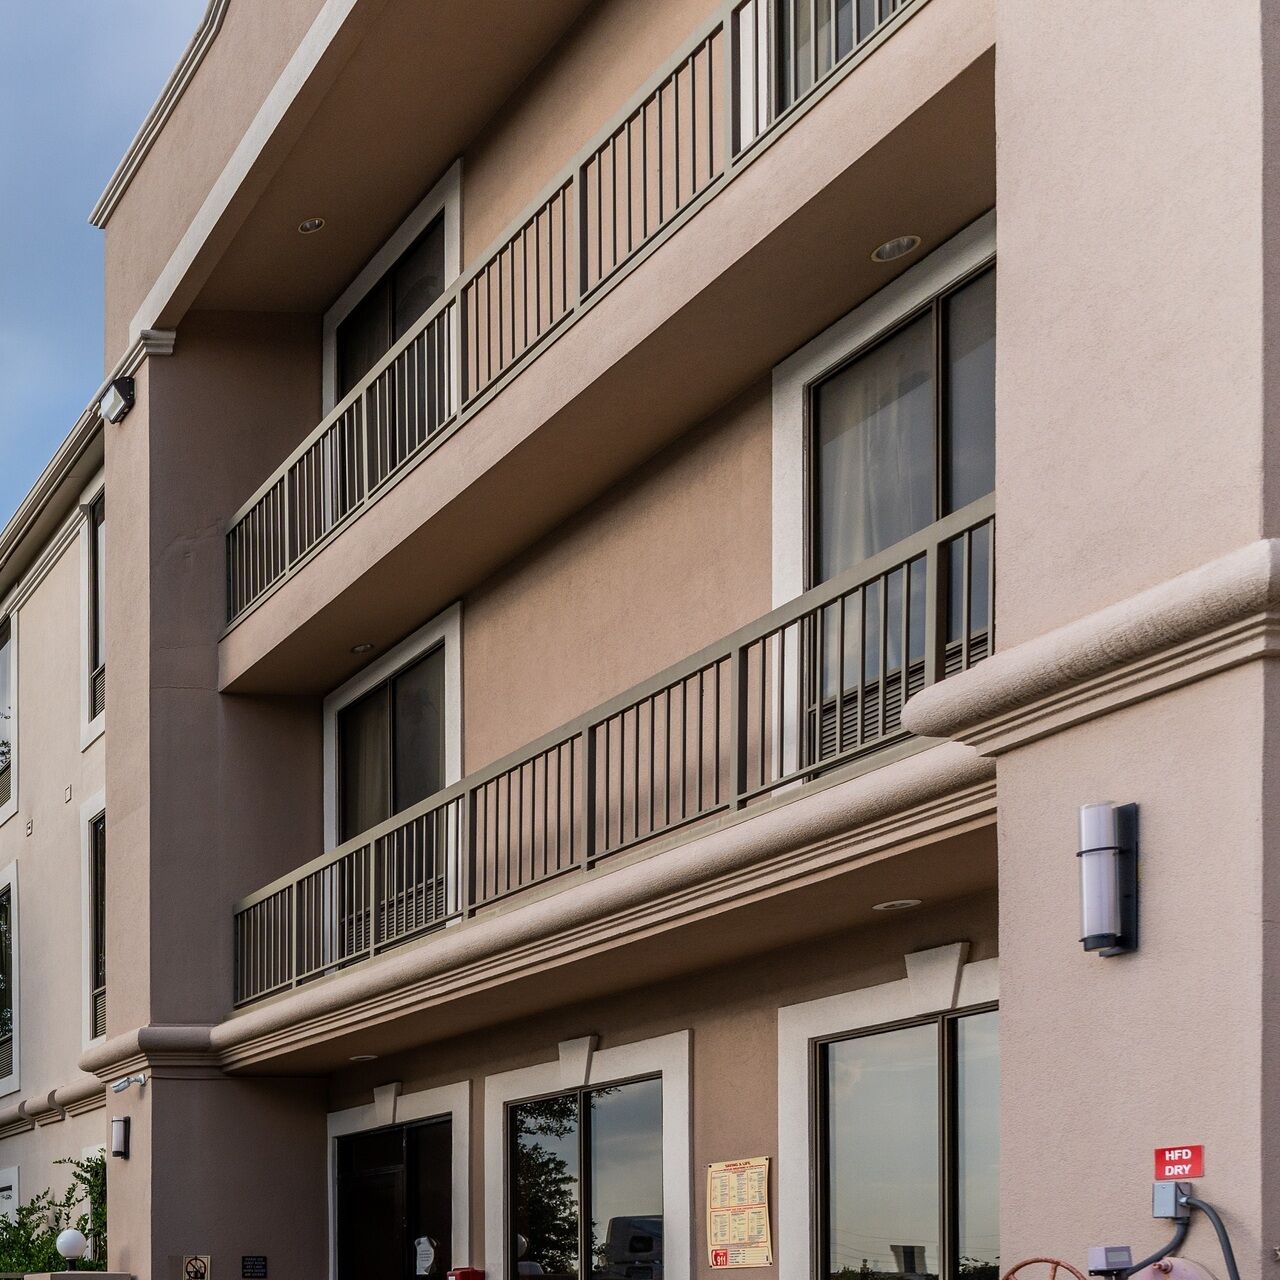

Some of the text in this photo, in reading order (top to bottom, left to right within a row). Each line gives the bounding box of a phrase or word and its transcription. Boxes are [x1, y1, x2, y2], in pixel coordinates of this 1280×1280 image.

[1165, 1149, 1192, 1161] HFD
[1165, 1164, 1192, 1176] DRY
[716, 1255, 726, 1266] 911
